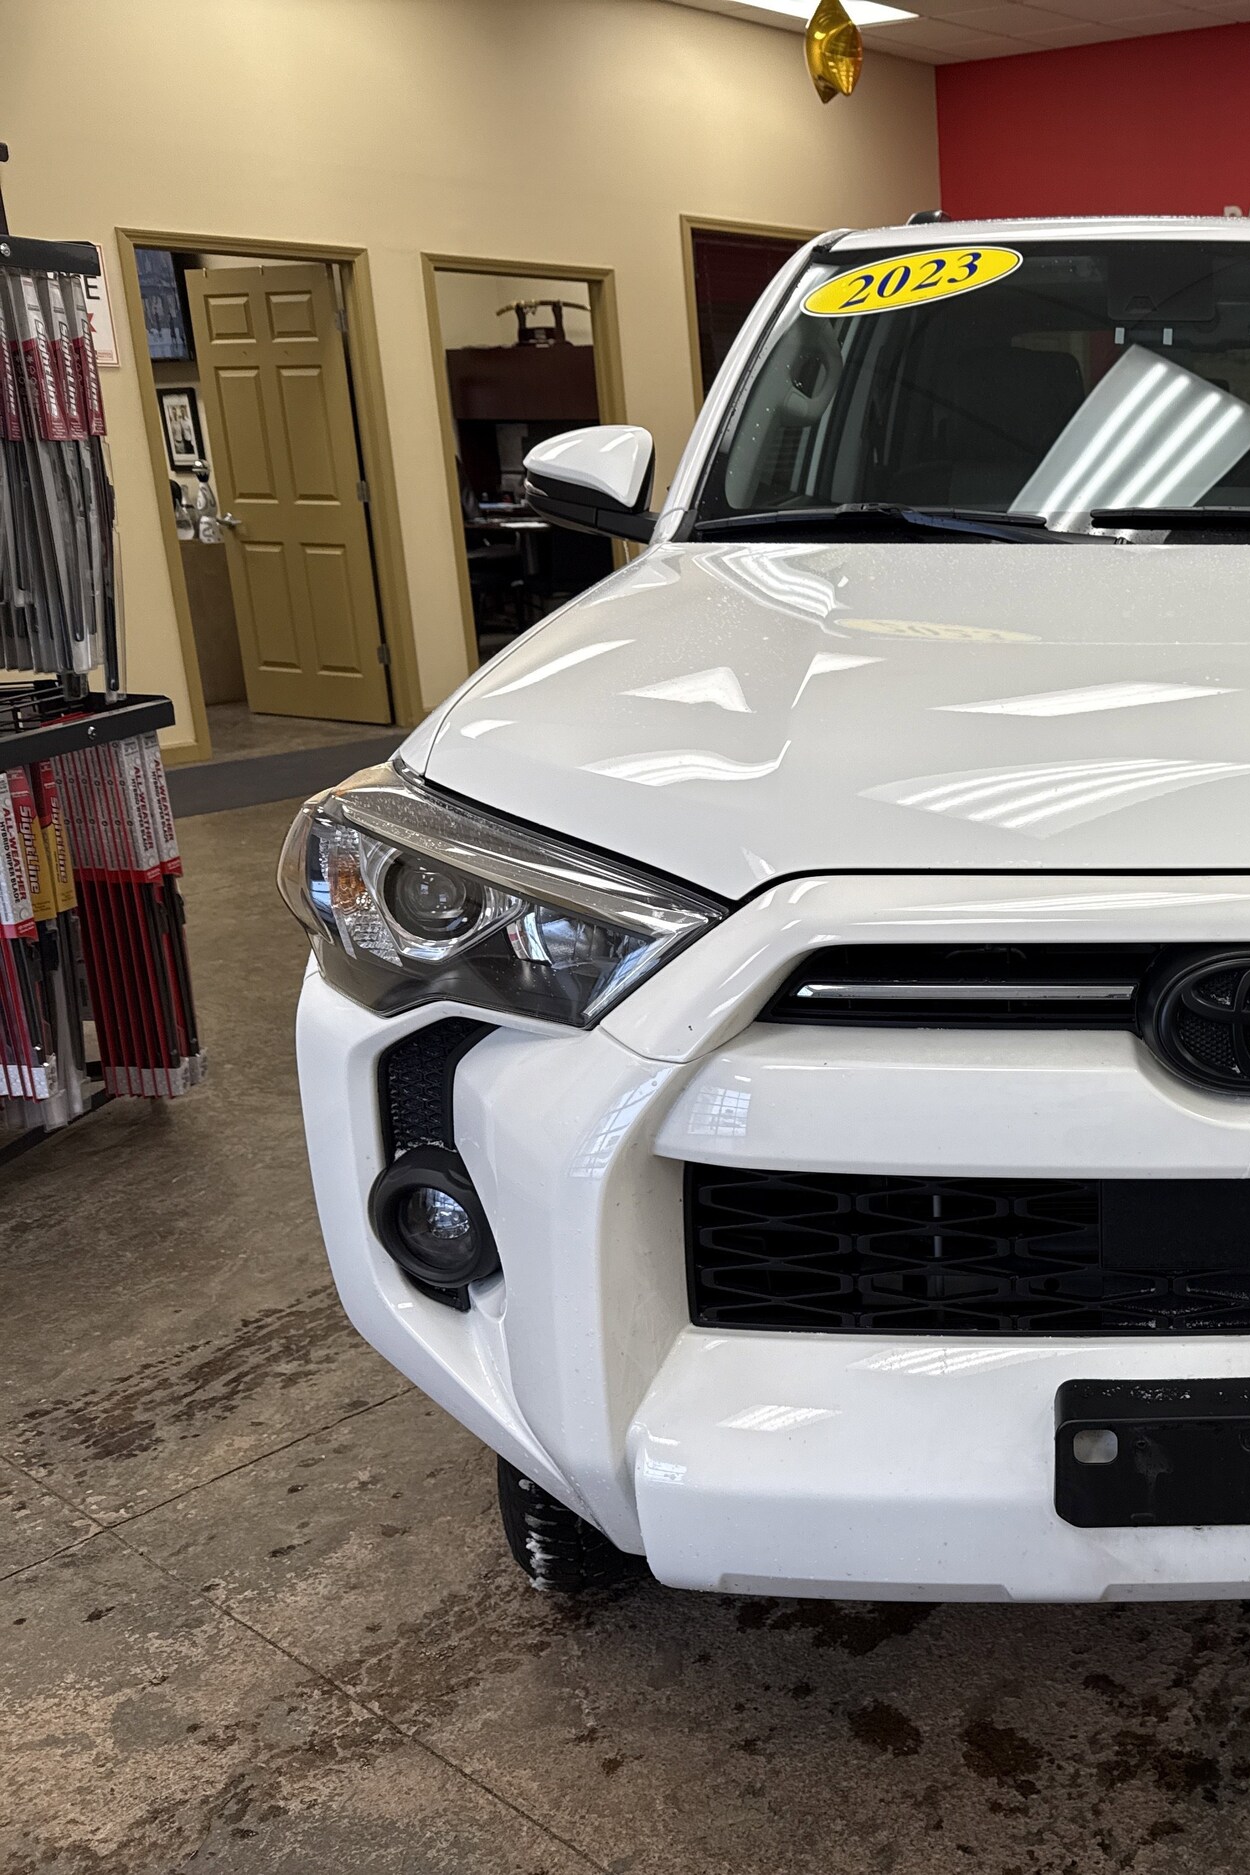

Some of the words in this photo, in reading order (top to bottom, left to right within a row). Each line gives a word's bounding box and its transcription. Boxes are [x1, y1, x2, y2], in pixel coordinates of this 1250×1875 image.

[838, 252, 982, 310] 2023
[134, 766, 154, 849] ALL-WEATHER
[154, 760, 174, 841] ALL-WEATHER
[0, 821, 10, 851] HYBRID
[2, 807, 27, 900] ALL-WEATHER
[4, 852, 16, 877] WIPER
[19, 805, 41, 894] SightLine
[10, 878, 21, 903] BLADE
